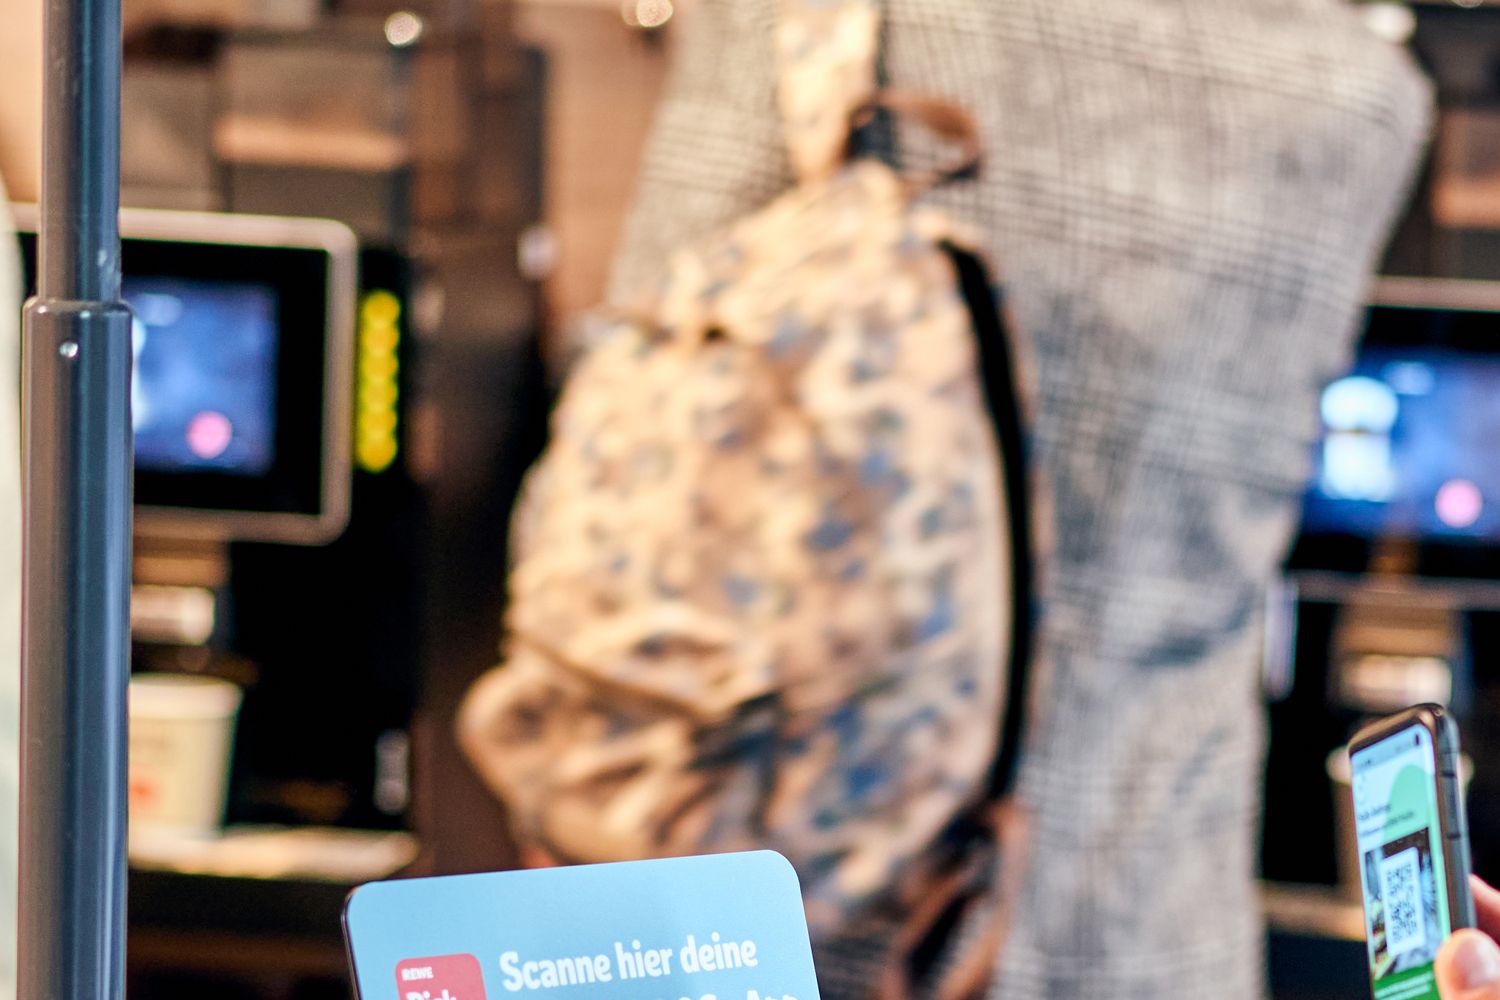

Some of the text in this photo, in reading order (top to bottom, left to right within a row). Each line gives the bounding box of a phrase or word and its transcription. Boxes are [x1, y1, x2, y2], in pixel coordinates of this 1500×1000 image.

[402, 966, 433, 981] REWE
[499, 932, 758, 991] Scanne hier deine
